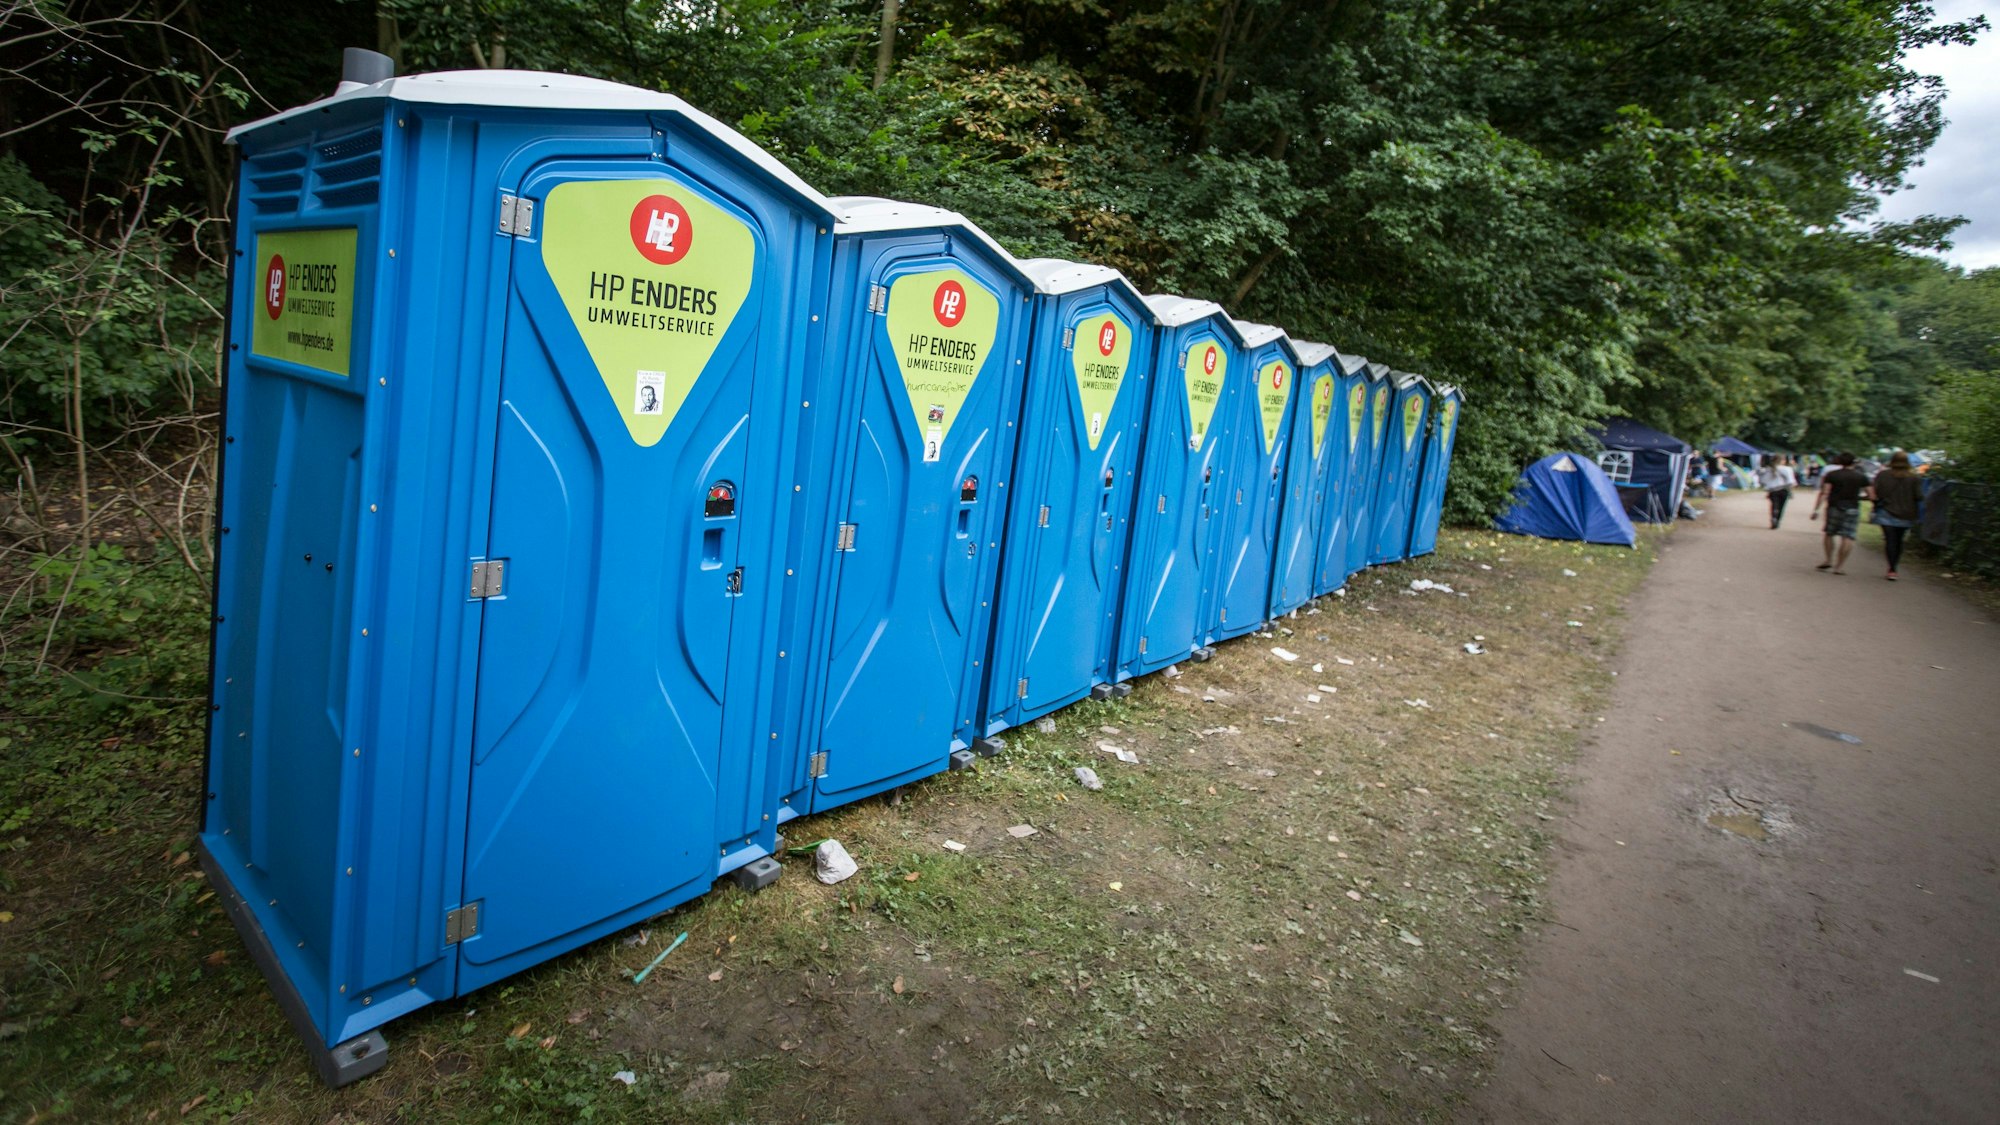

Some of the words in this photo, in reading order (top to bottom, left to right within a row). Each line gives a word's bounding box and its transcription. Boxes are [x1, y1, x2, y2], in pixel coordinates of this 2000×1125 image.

[289, 264, 301, 291] HP
[302, 264, 337, 294] ENDERS
[589, 271, 625, 302] HP
[631, 278, 717, 316] ENDERS
[288, 297, 335, 318] UMWELTSERVICE
[588, 306, 714, 337] UMWELTSERVICE
[288, 328, 334, 352] www.hpenders.de
[908, 333, 928, 354] HP
[930, 337, 977, 361] ENDERS
[907, 357, 974, 376] UMWELTSERVICE
[1084, 362, 1095, 378] HP
[1095, 364, 1120, 380] ENDERS
